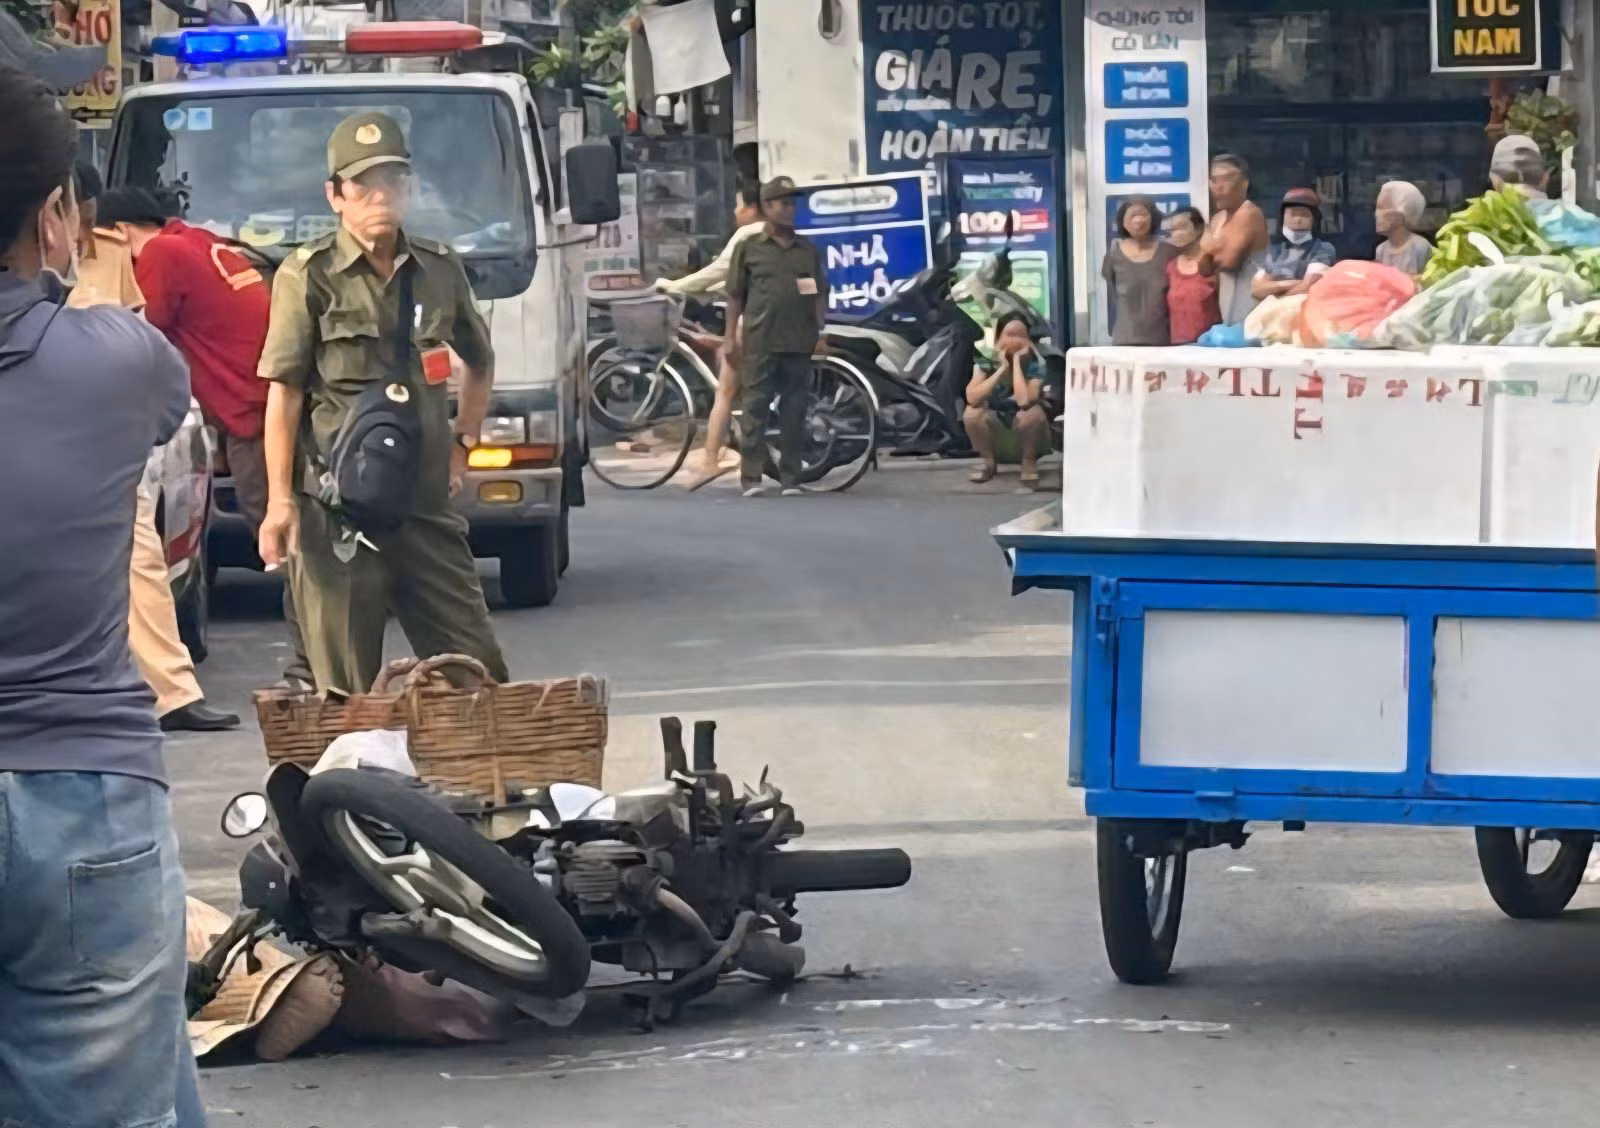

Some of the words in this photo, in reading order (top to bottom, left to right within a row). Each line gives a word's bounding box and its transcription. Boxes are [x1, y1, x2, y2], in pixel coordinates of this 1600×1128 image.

[875, 34, 952, 91] GIÁ
[1453, 27, 1521, 56] NAM
[880, 119, 974, 161] HOÀN
